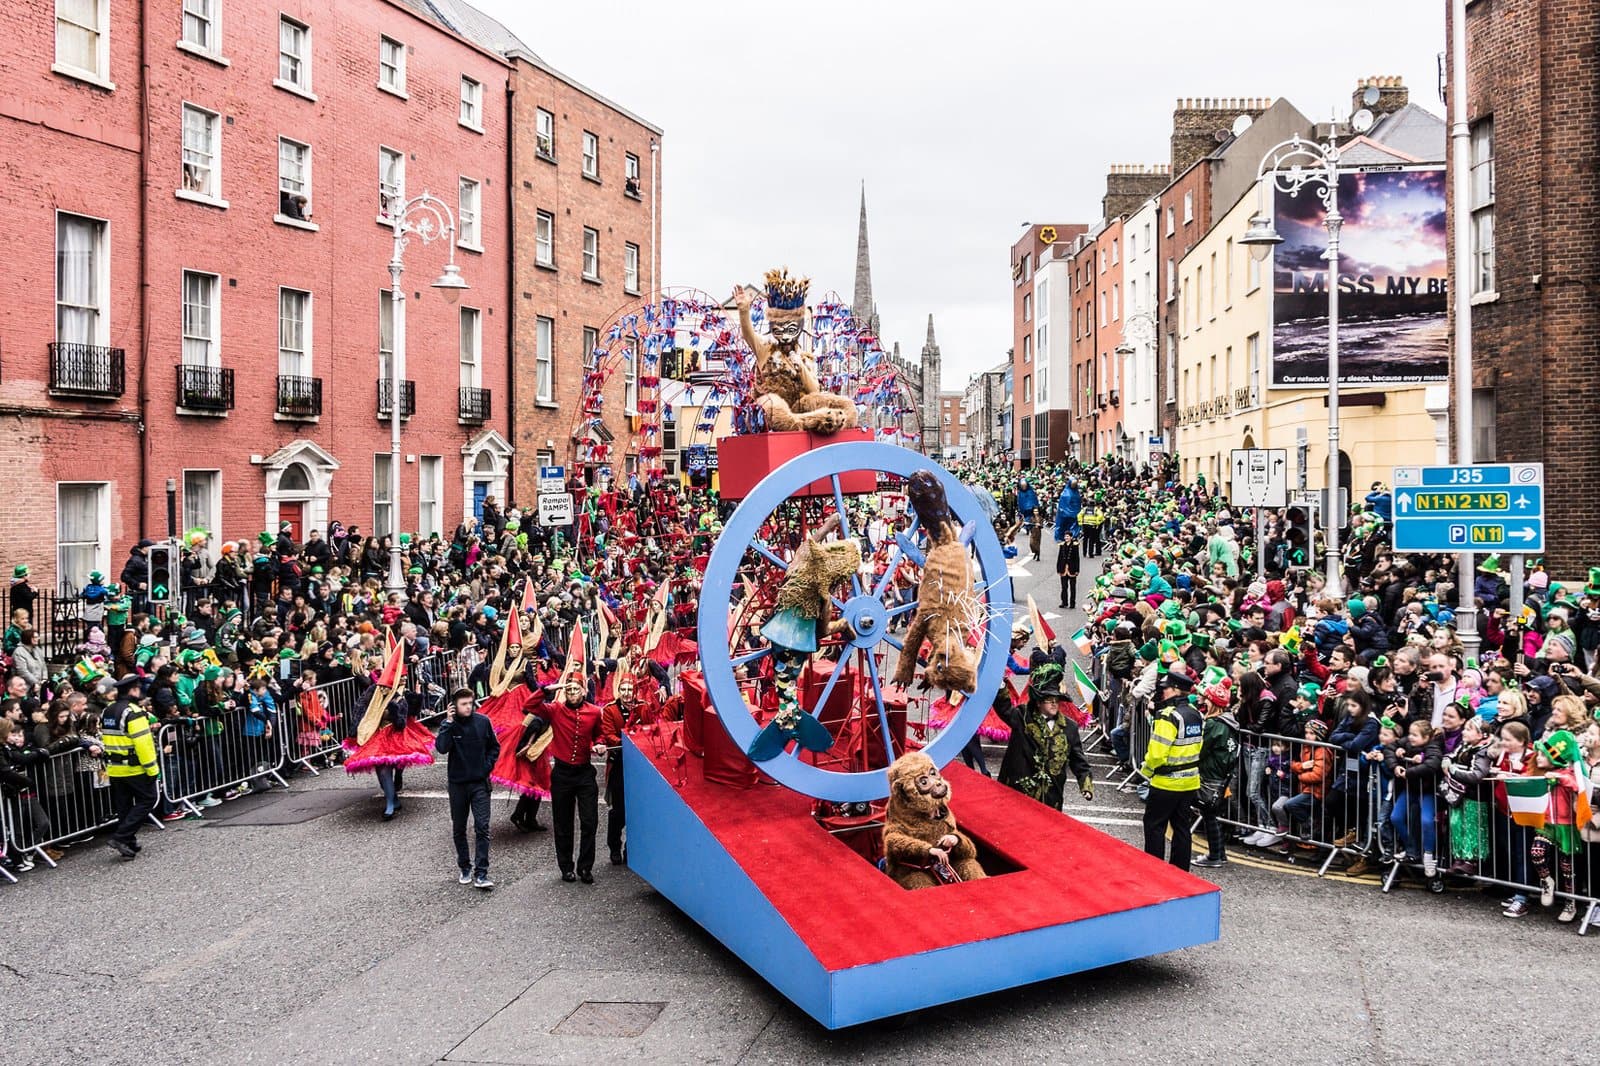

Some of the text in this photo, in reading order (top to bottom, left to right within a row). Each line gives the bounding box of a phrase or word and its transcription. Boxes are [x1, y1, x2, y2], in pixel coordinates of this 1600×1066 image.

[1293, 272, 1375, 295] MSS
[1386, 276, 1420, 294] MY
[1449, 469, 1483, 483] J35
[1452, 528, 1463, 541] P
